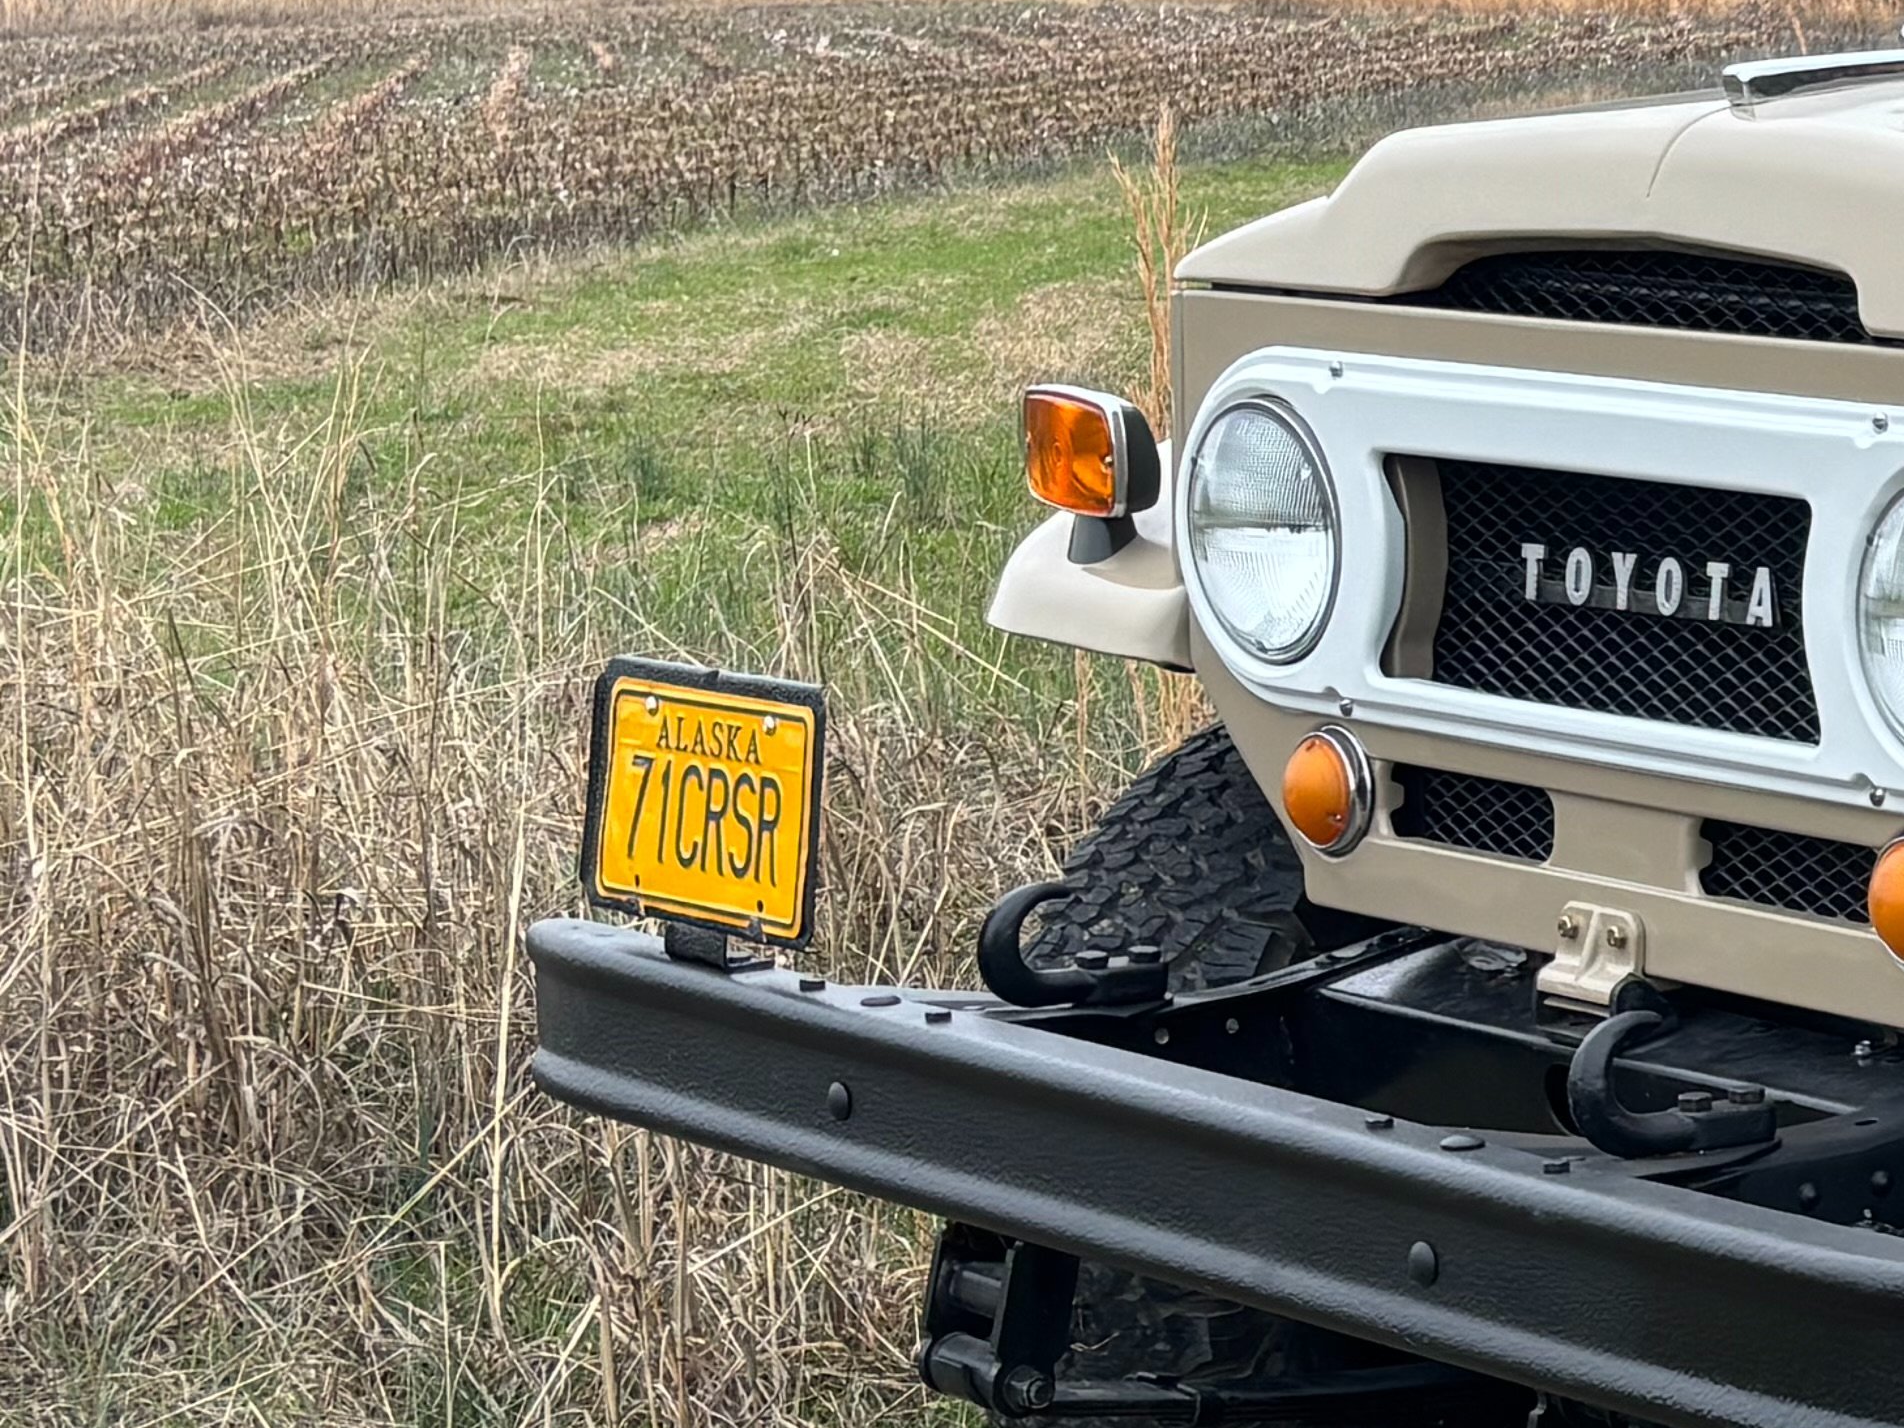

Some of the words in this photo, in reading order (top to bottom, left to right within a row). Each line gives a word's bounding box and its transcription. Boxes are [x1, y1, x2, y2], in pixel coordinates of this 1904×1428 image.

[1520, 542, 1777, 628] TOYOTA
[655, 715, 763, 765] ALASKA
[626, 753, 782, 888] 71CRSR
